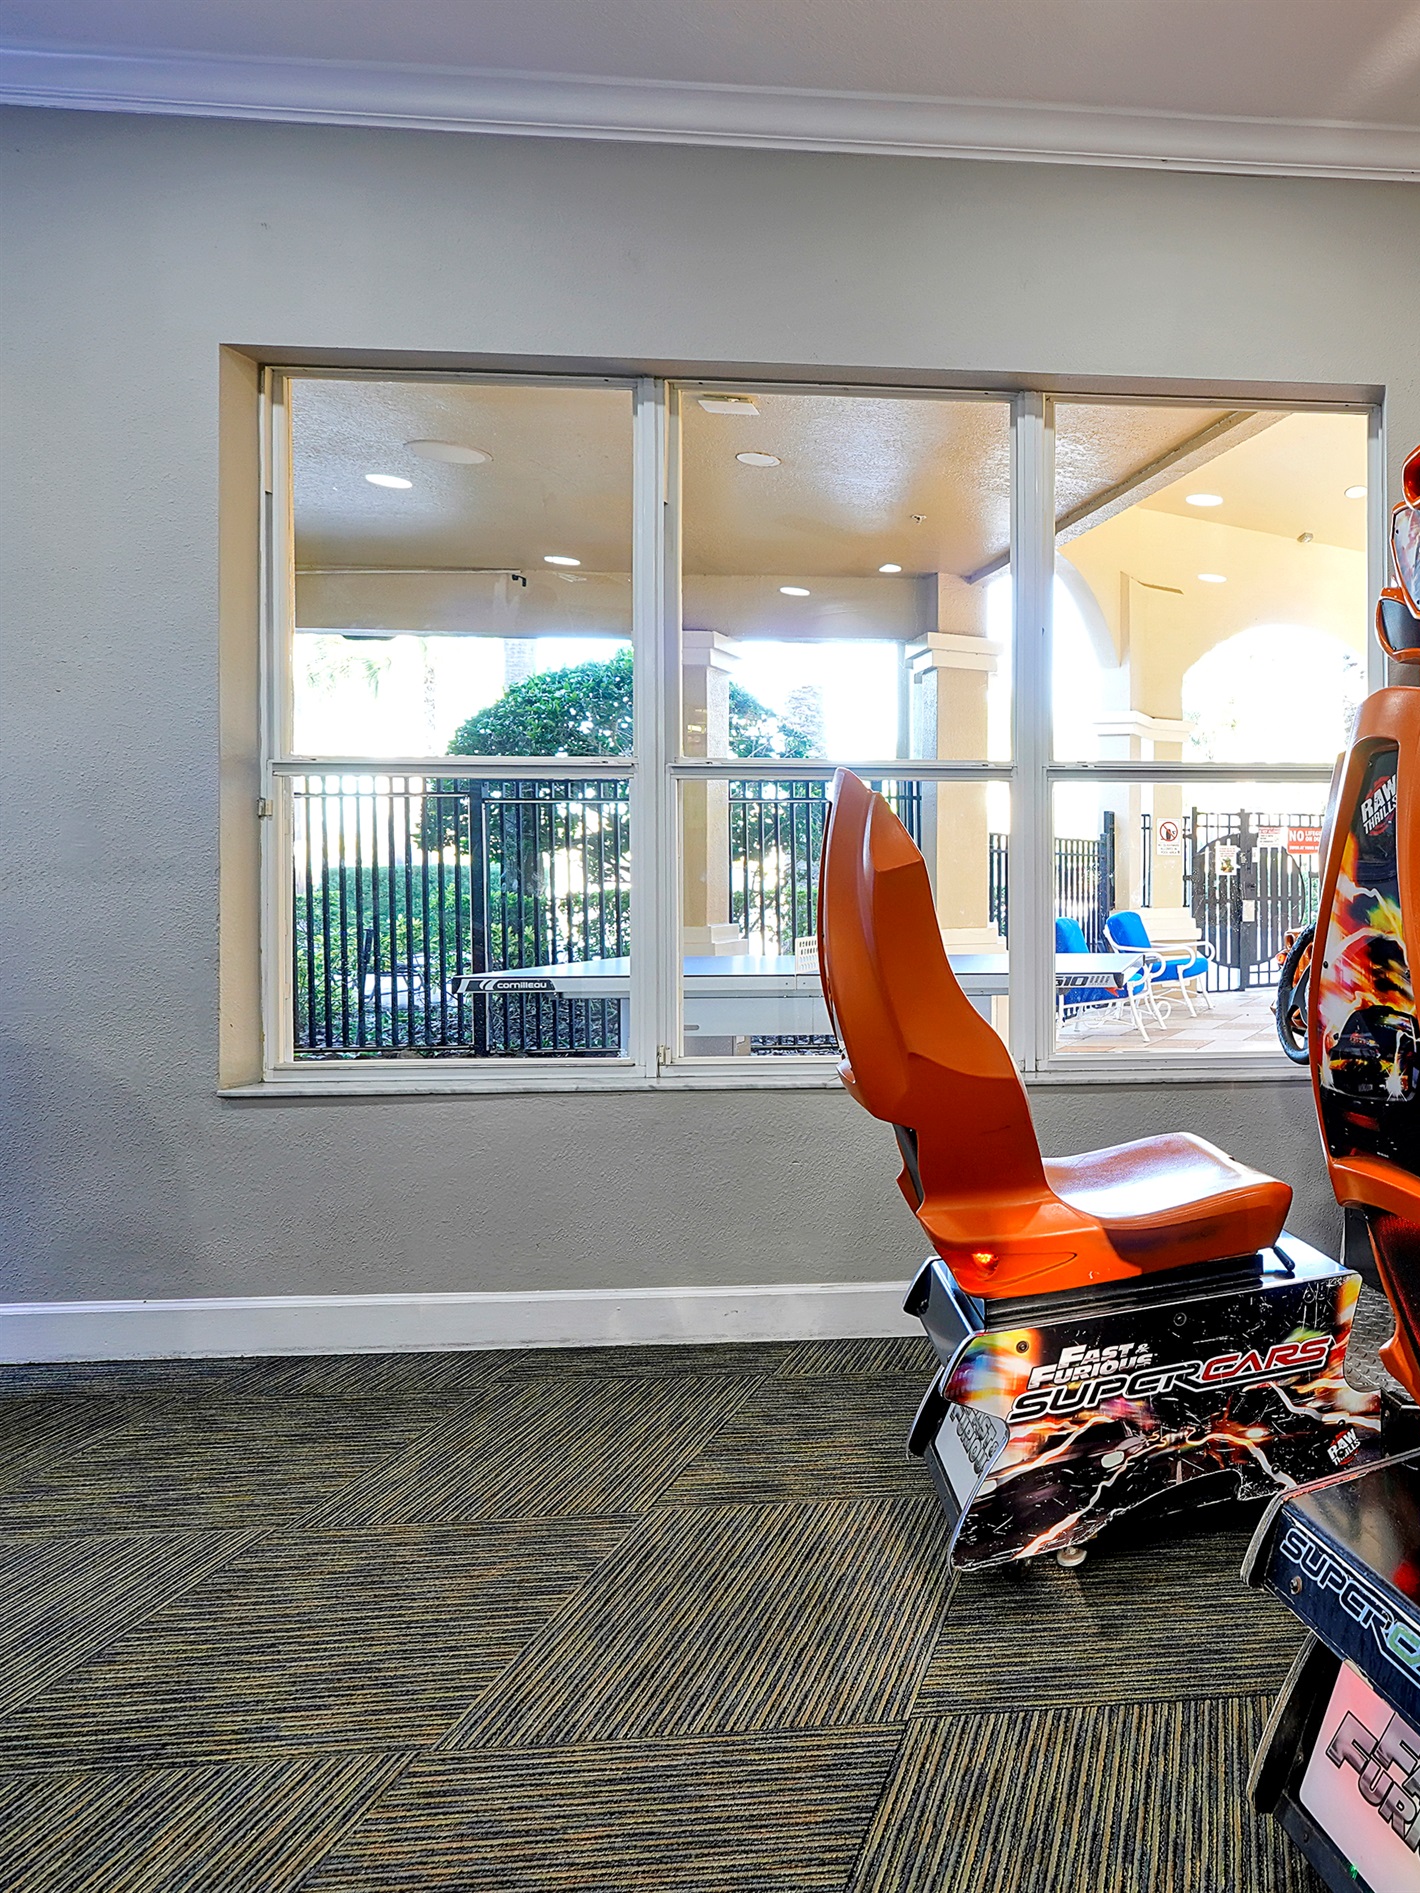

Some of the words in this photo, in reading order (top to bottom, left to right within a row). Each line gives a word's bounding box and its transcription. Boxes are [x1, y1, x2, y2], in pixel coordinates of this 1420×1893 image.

[1361, 774, 1397, 823] RAW
[1363, 795, 1397, 835] THRILLS
[1289, 830, 1305, 842] NO
[1027, 1351, 1154, 1390] FURIOUS
[1058, 1342, 1135, 1369] FAST
[1136, 1342, 1150, 1354] &
[1327, 1428, 1357, 1461] RAW
